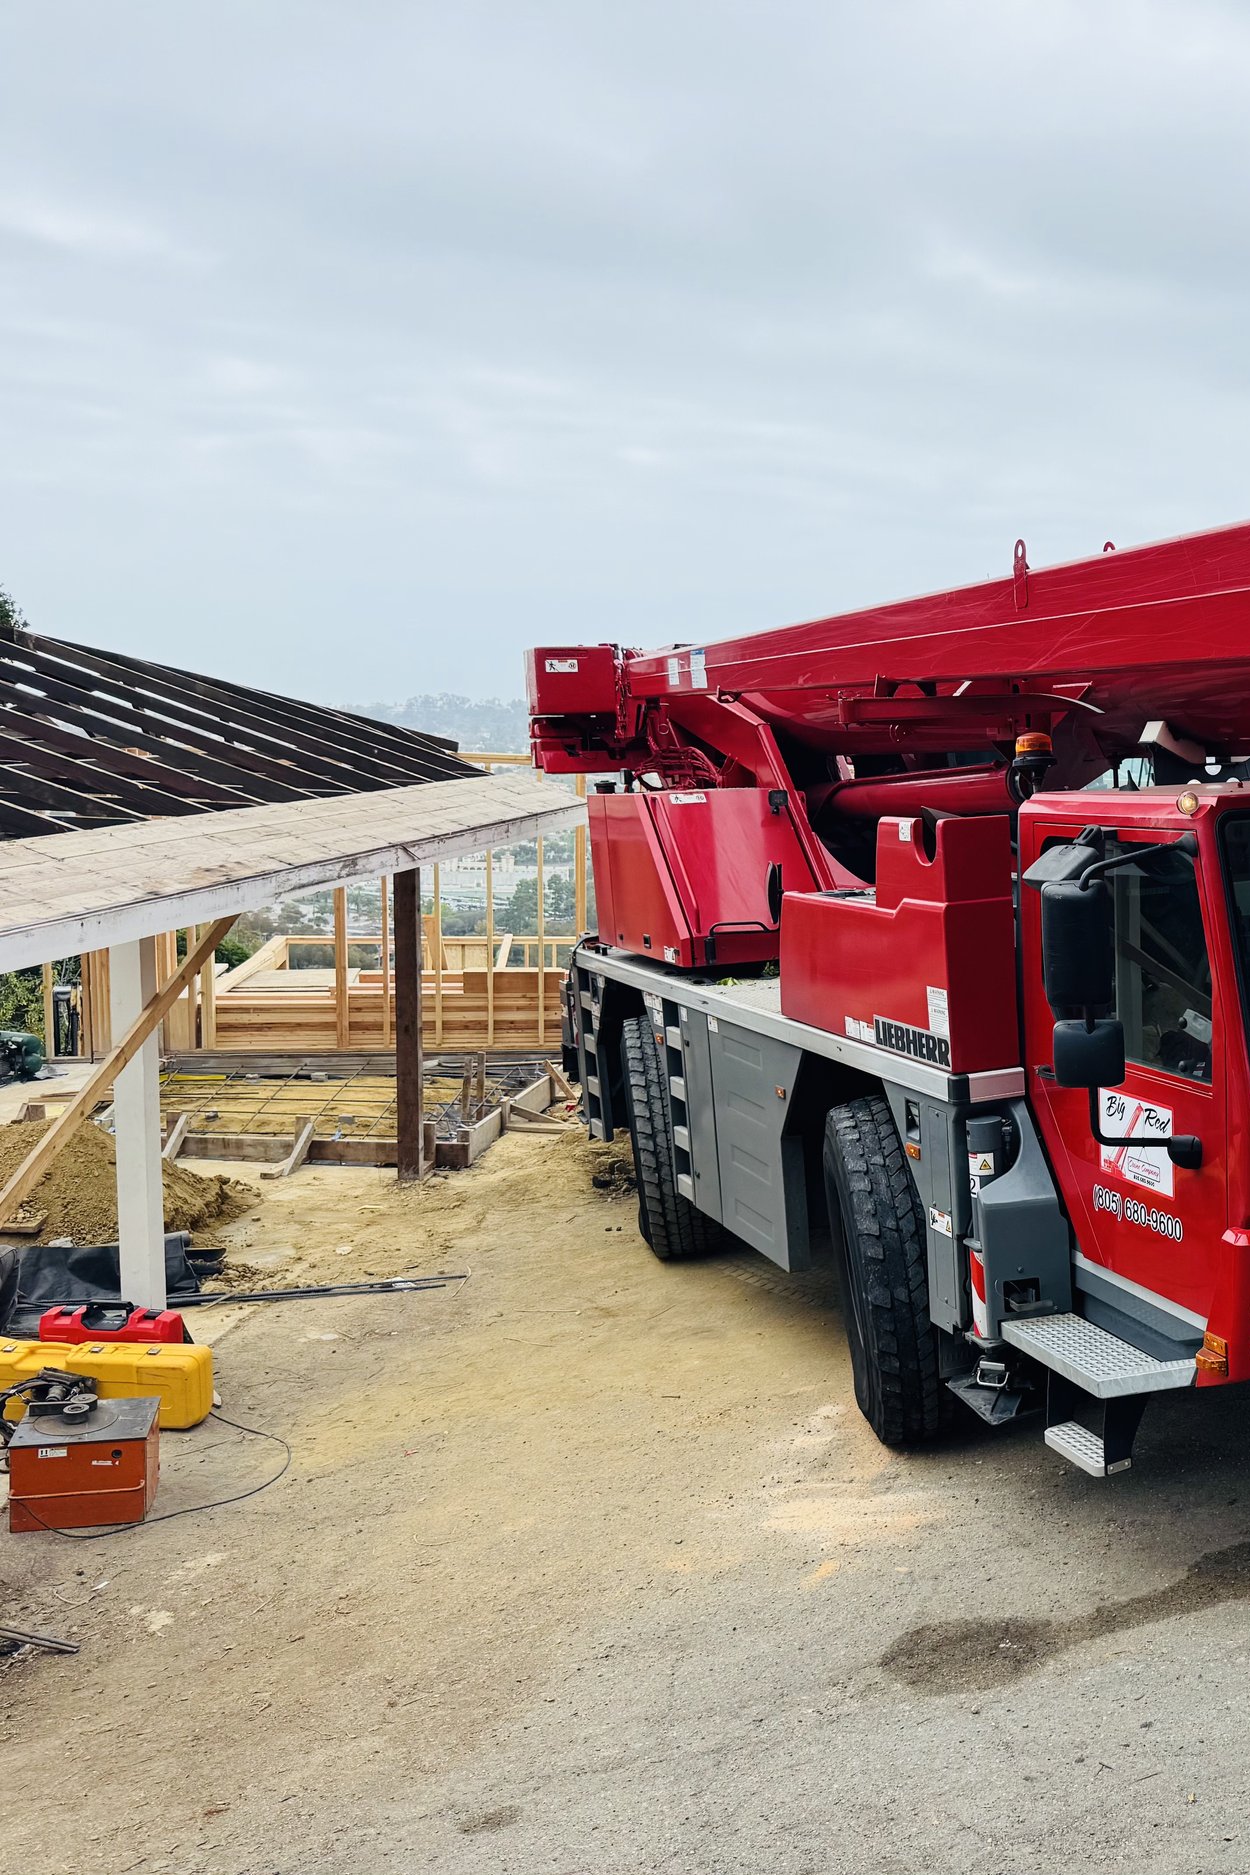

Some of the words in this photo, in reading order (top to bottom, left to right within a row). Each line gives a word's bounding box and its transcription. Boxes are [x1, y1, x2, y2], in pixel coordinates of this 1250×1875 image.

[874, 1018, 951, 1068] LIEBHERR
[1106, 1095, 1126, 1121] Big
[1144, 1108, 1171, 1134] Red
[1093, 1184, 1123, 1221] (805)
[1124, 1197, 1184, 1242] 680-9600
